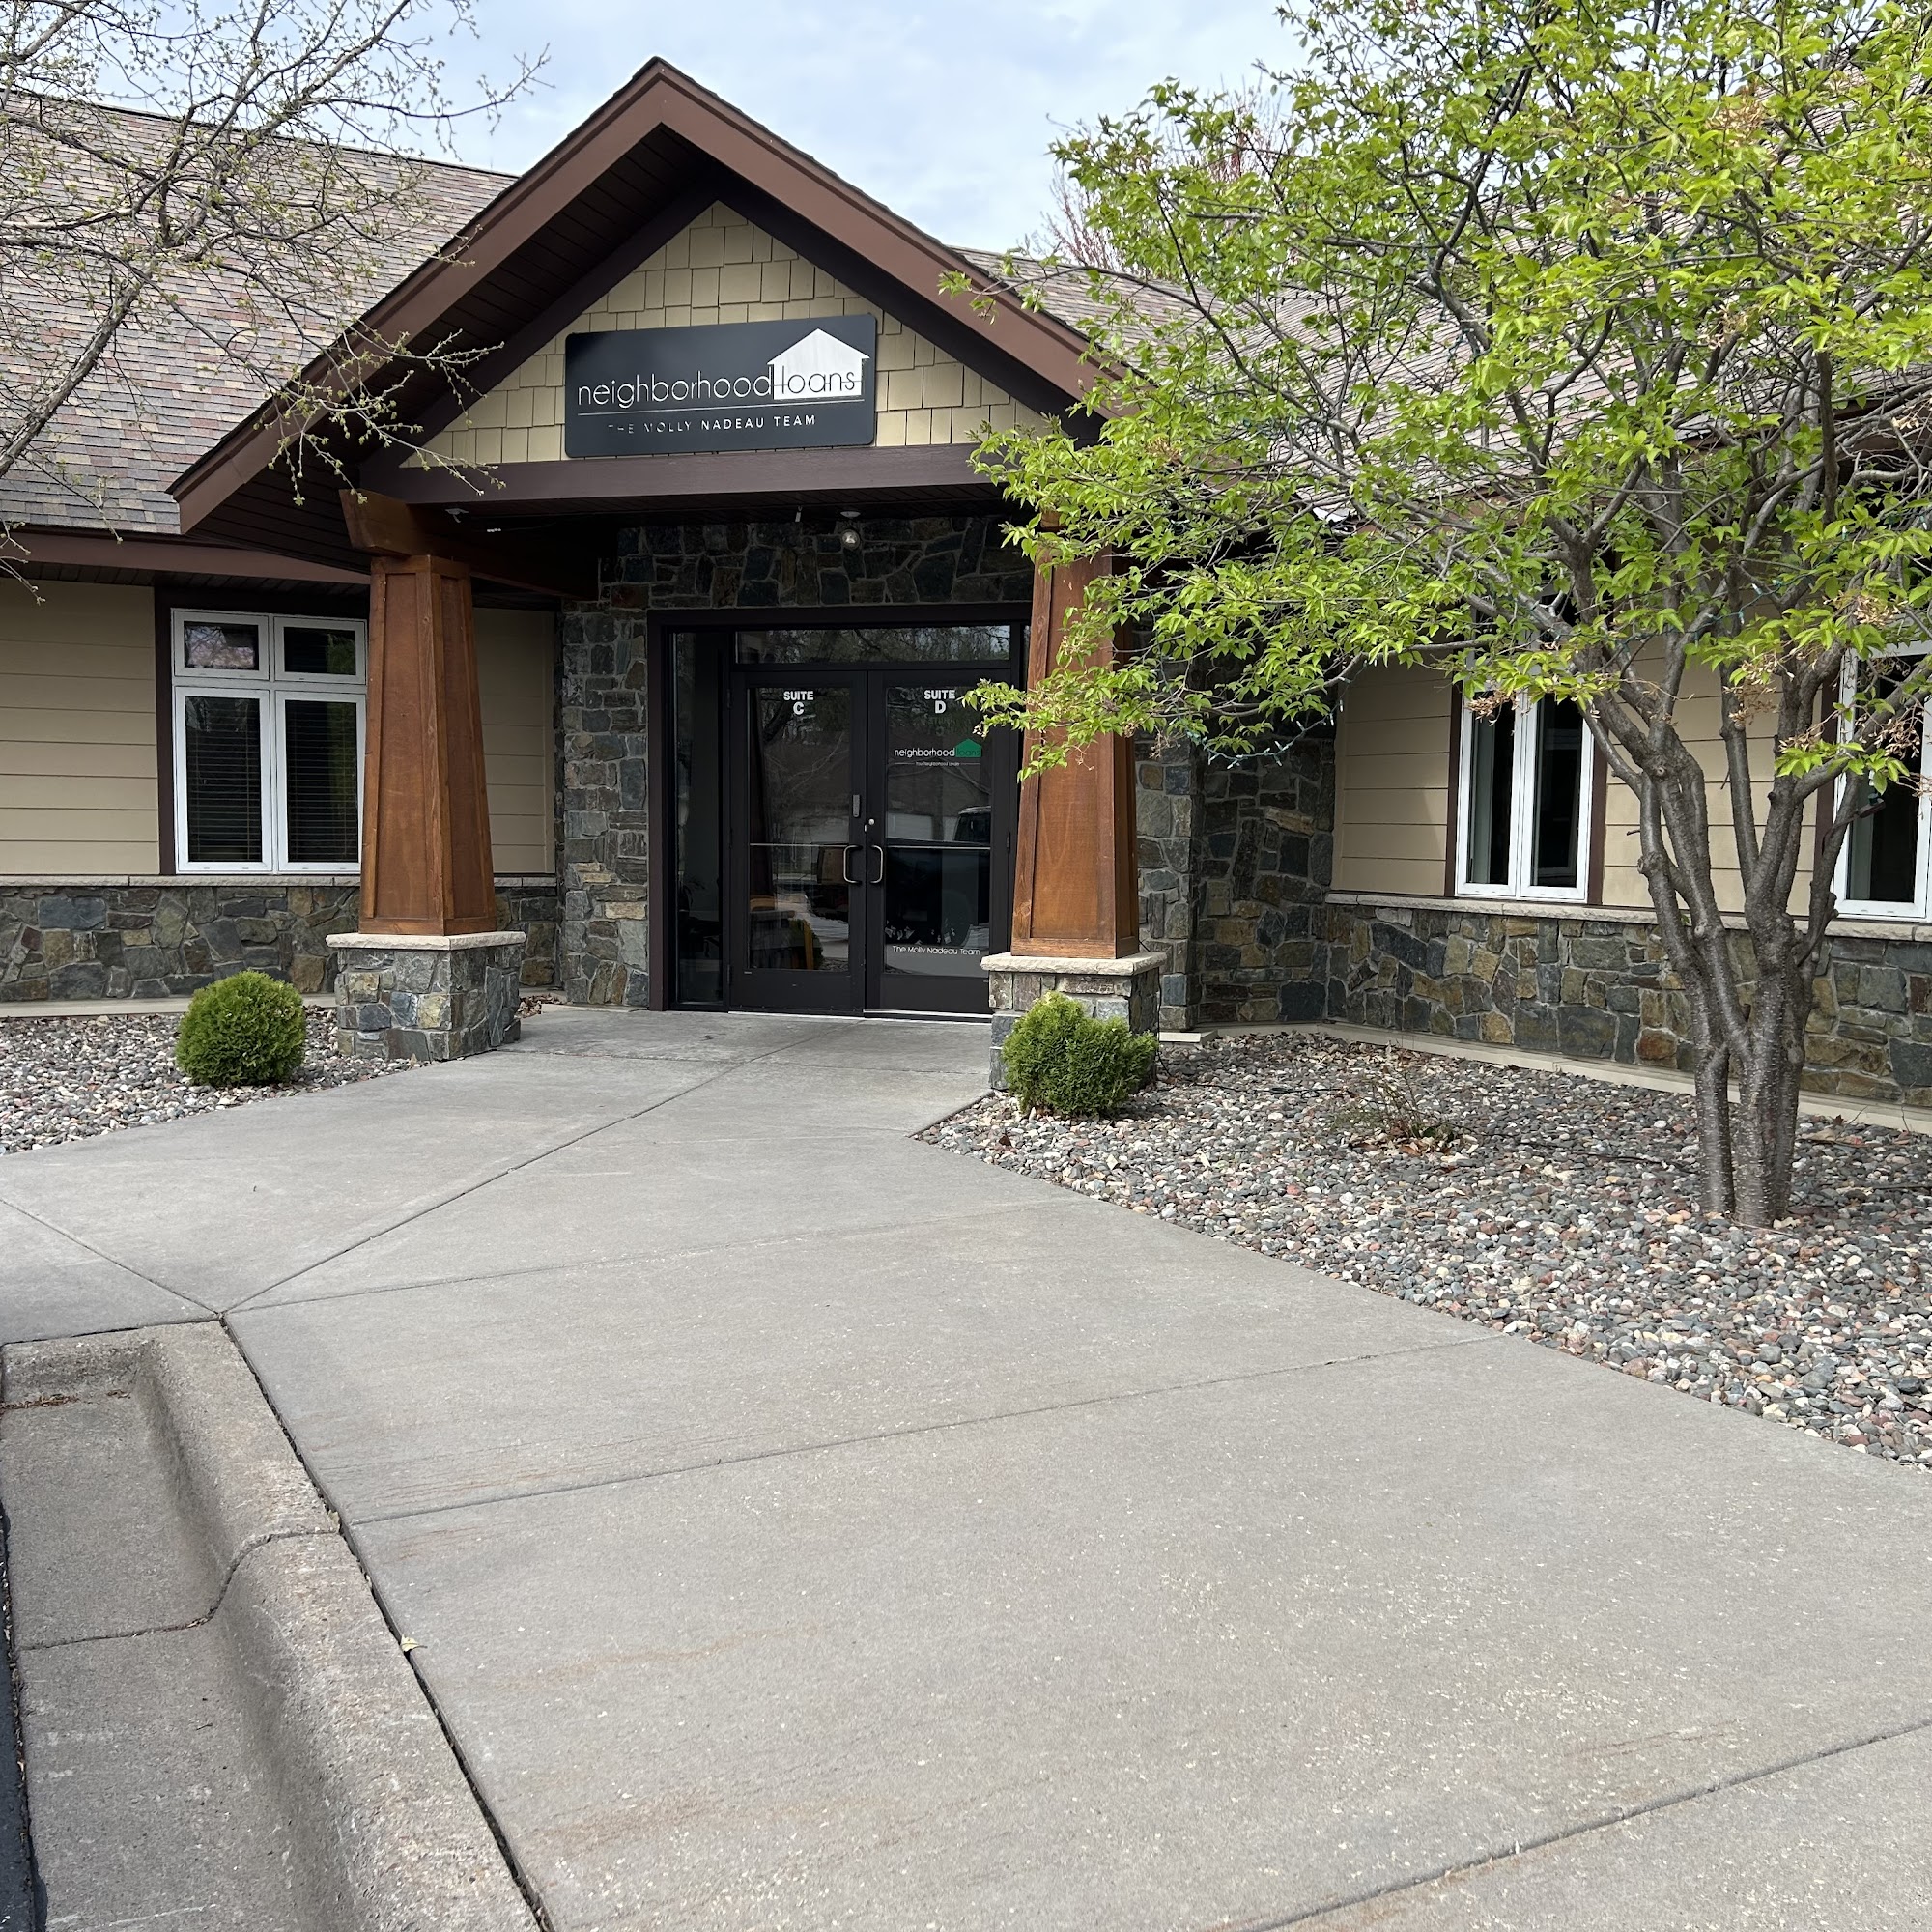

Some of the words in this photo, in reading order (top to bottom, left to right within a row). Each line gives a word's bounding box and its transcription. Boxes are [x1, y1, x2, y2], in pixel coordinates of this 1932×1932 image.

[578, 367, 772, 409] neighborhood
[781, 364, 855, 395] loans
[700, 417, 764, 431] NADEAU
[773, 414, 815, 427] TEAM
[783, 691, 813, 701] SUITE
[923, 690, 955, 700] SUITE
[793, 701, 805, 716] C
[934, 700, 947, 714] D
[895, 748, 955, 758] neighborhood
[926, 947, 958, 955] Nadeau
